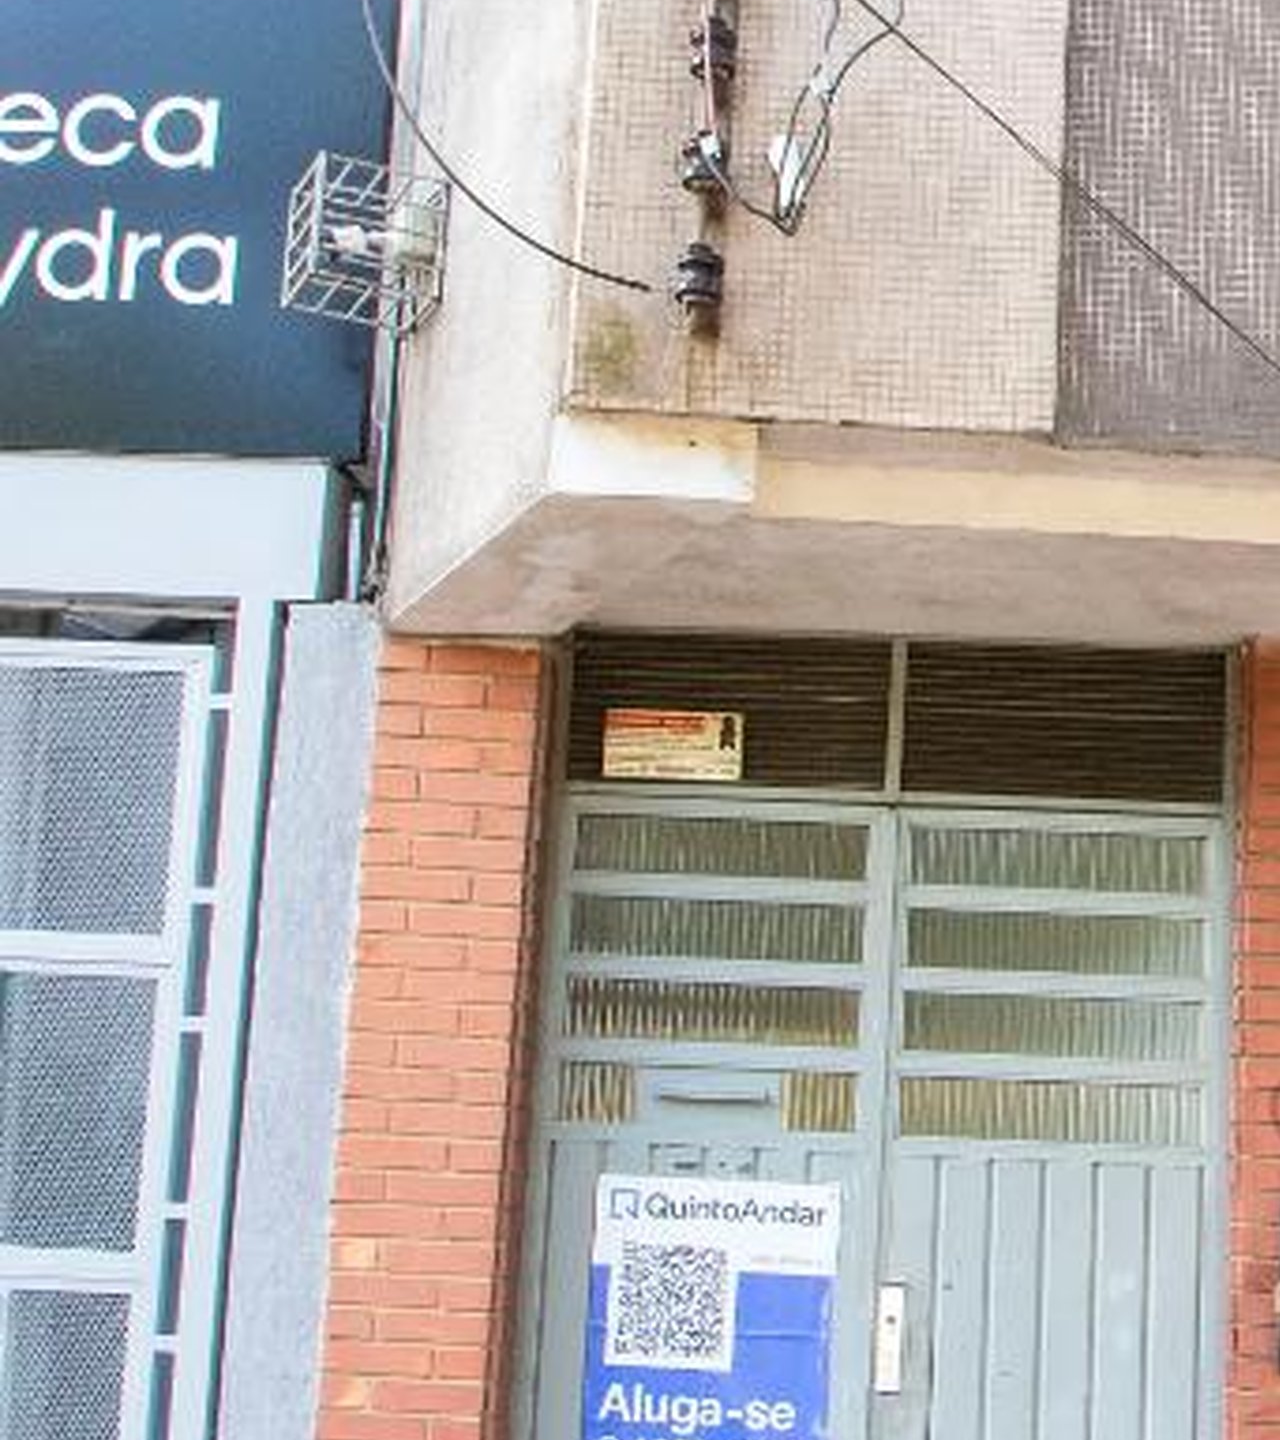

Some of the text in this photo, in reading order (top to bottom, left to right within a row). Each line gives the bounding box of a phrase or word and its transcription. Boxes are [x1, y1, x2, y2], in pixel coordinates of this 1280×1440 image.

[0, 92, 220, 170] eca
[645, 1192, 826, 1226] QuintoAndar
[599, 1383, 796, 1434] Aluga-se
